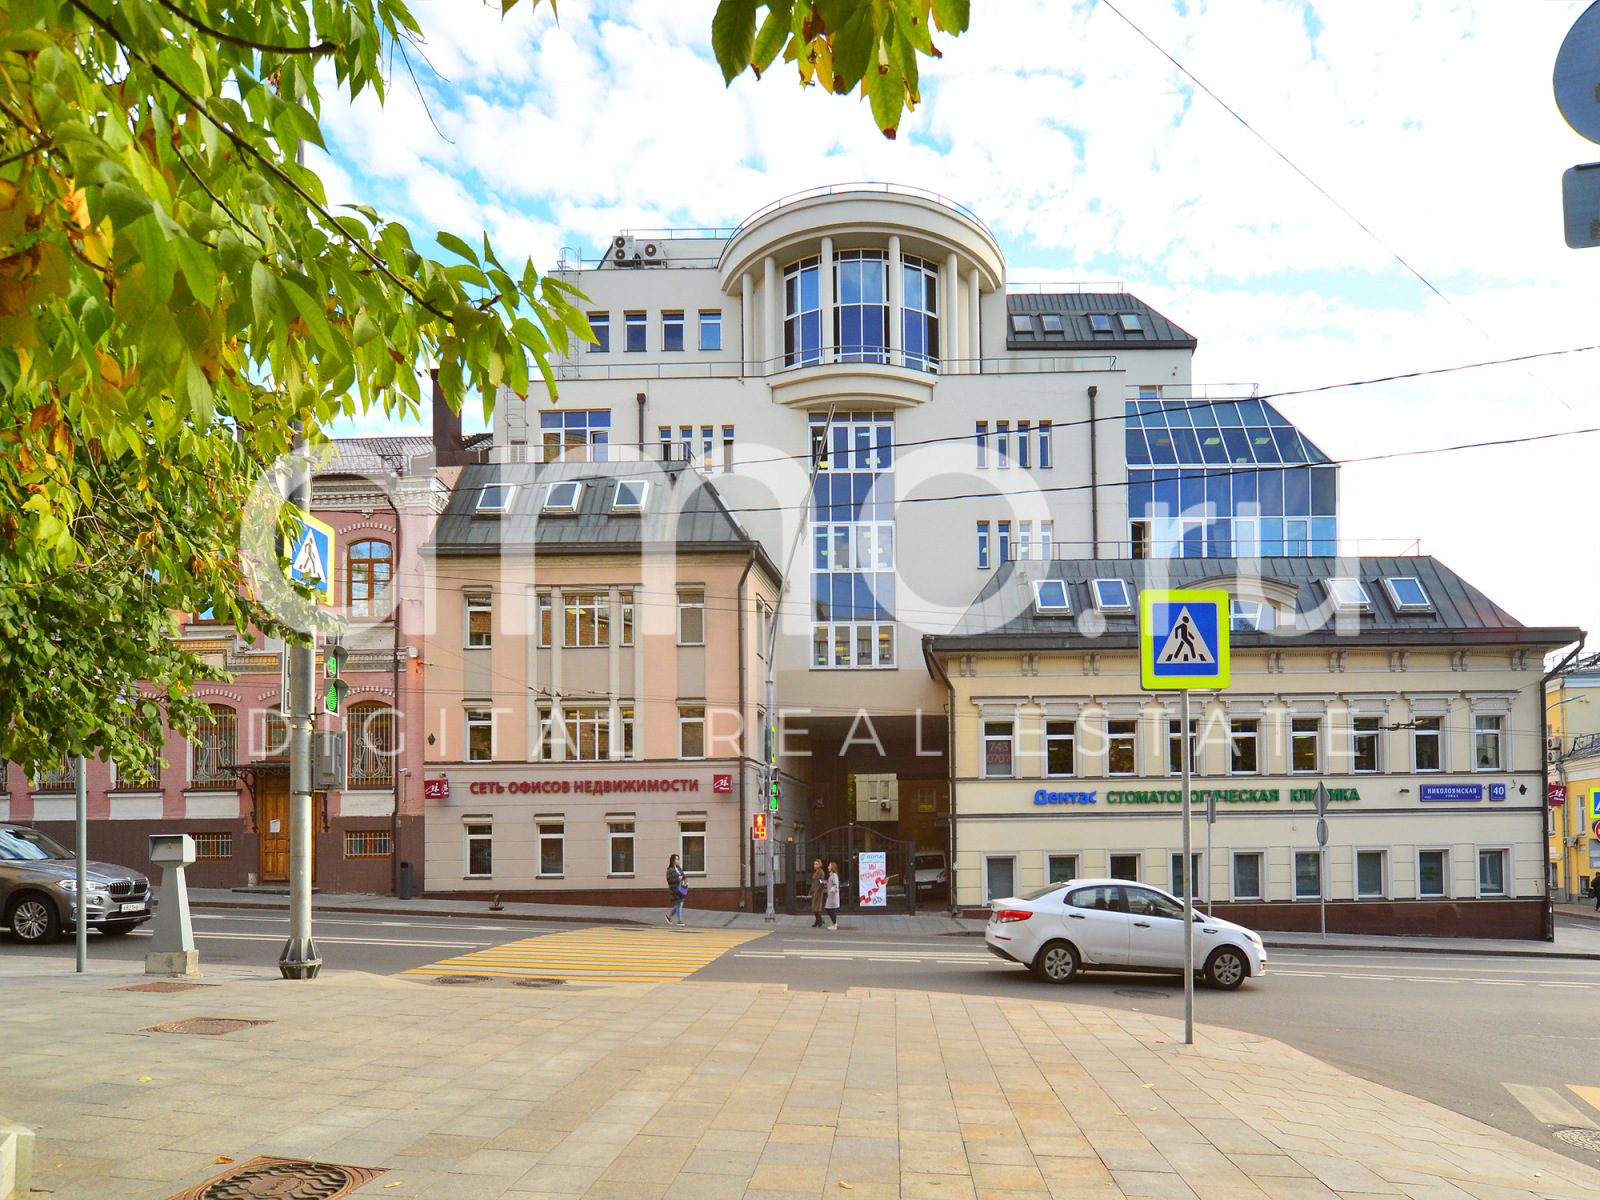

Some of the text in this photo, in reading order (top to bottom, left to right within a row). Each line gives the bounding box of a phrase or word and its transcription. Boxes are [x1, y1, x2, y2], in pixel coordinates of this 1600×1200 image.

[469, 781, 505, 794] СЕТЬ
[508, 780, 570, 795] ОФИСОВ
[573, 779, 699, 795] НЕДВИЖИМОСТИ
[1493, 786, 1504, 796] 40
[1034, 789, 1097, 804] Дентас
